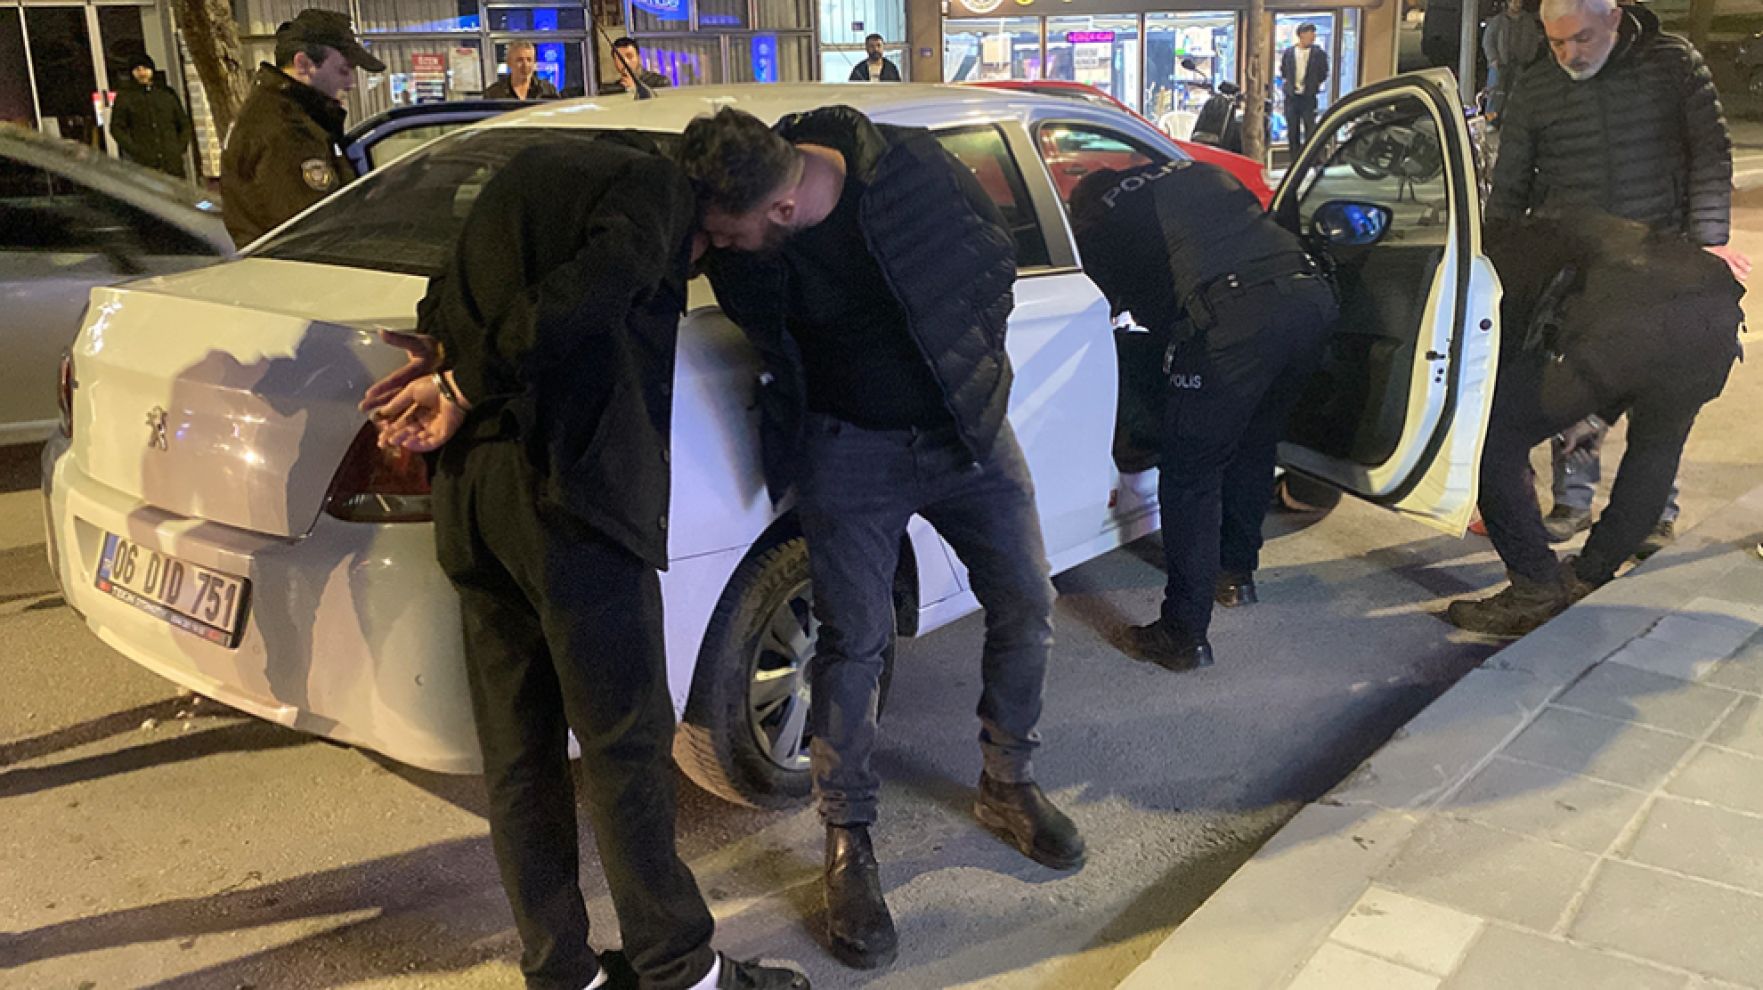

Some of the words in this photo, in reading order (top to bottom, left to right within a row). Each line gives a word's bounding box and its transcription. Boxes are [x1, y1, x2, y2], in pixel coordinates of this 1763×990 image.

[113, 540, 138, 584] 06
[143, 552, 184, 605] DID
[191, 571, 237, 628] 751
